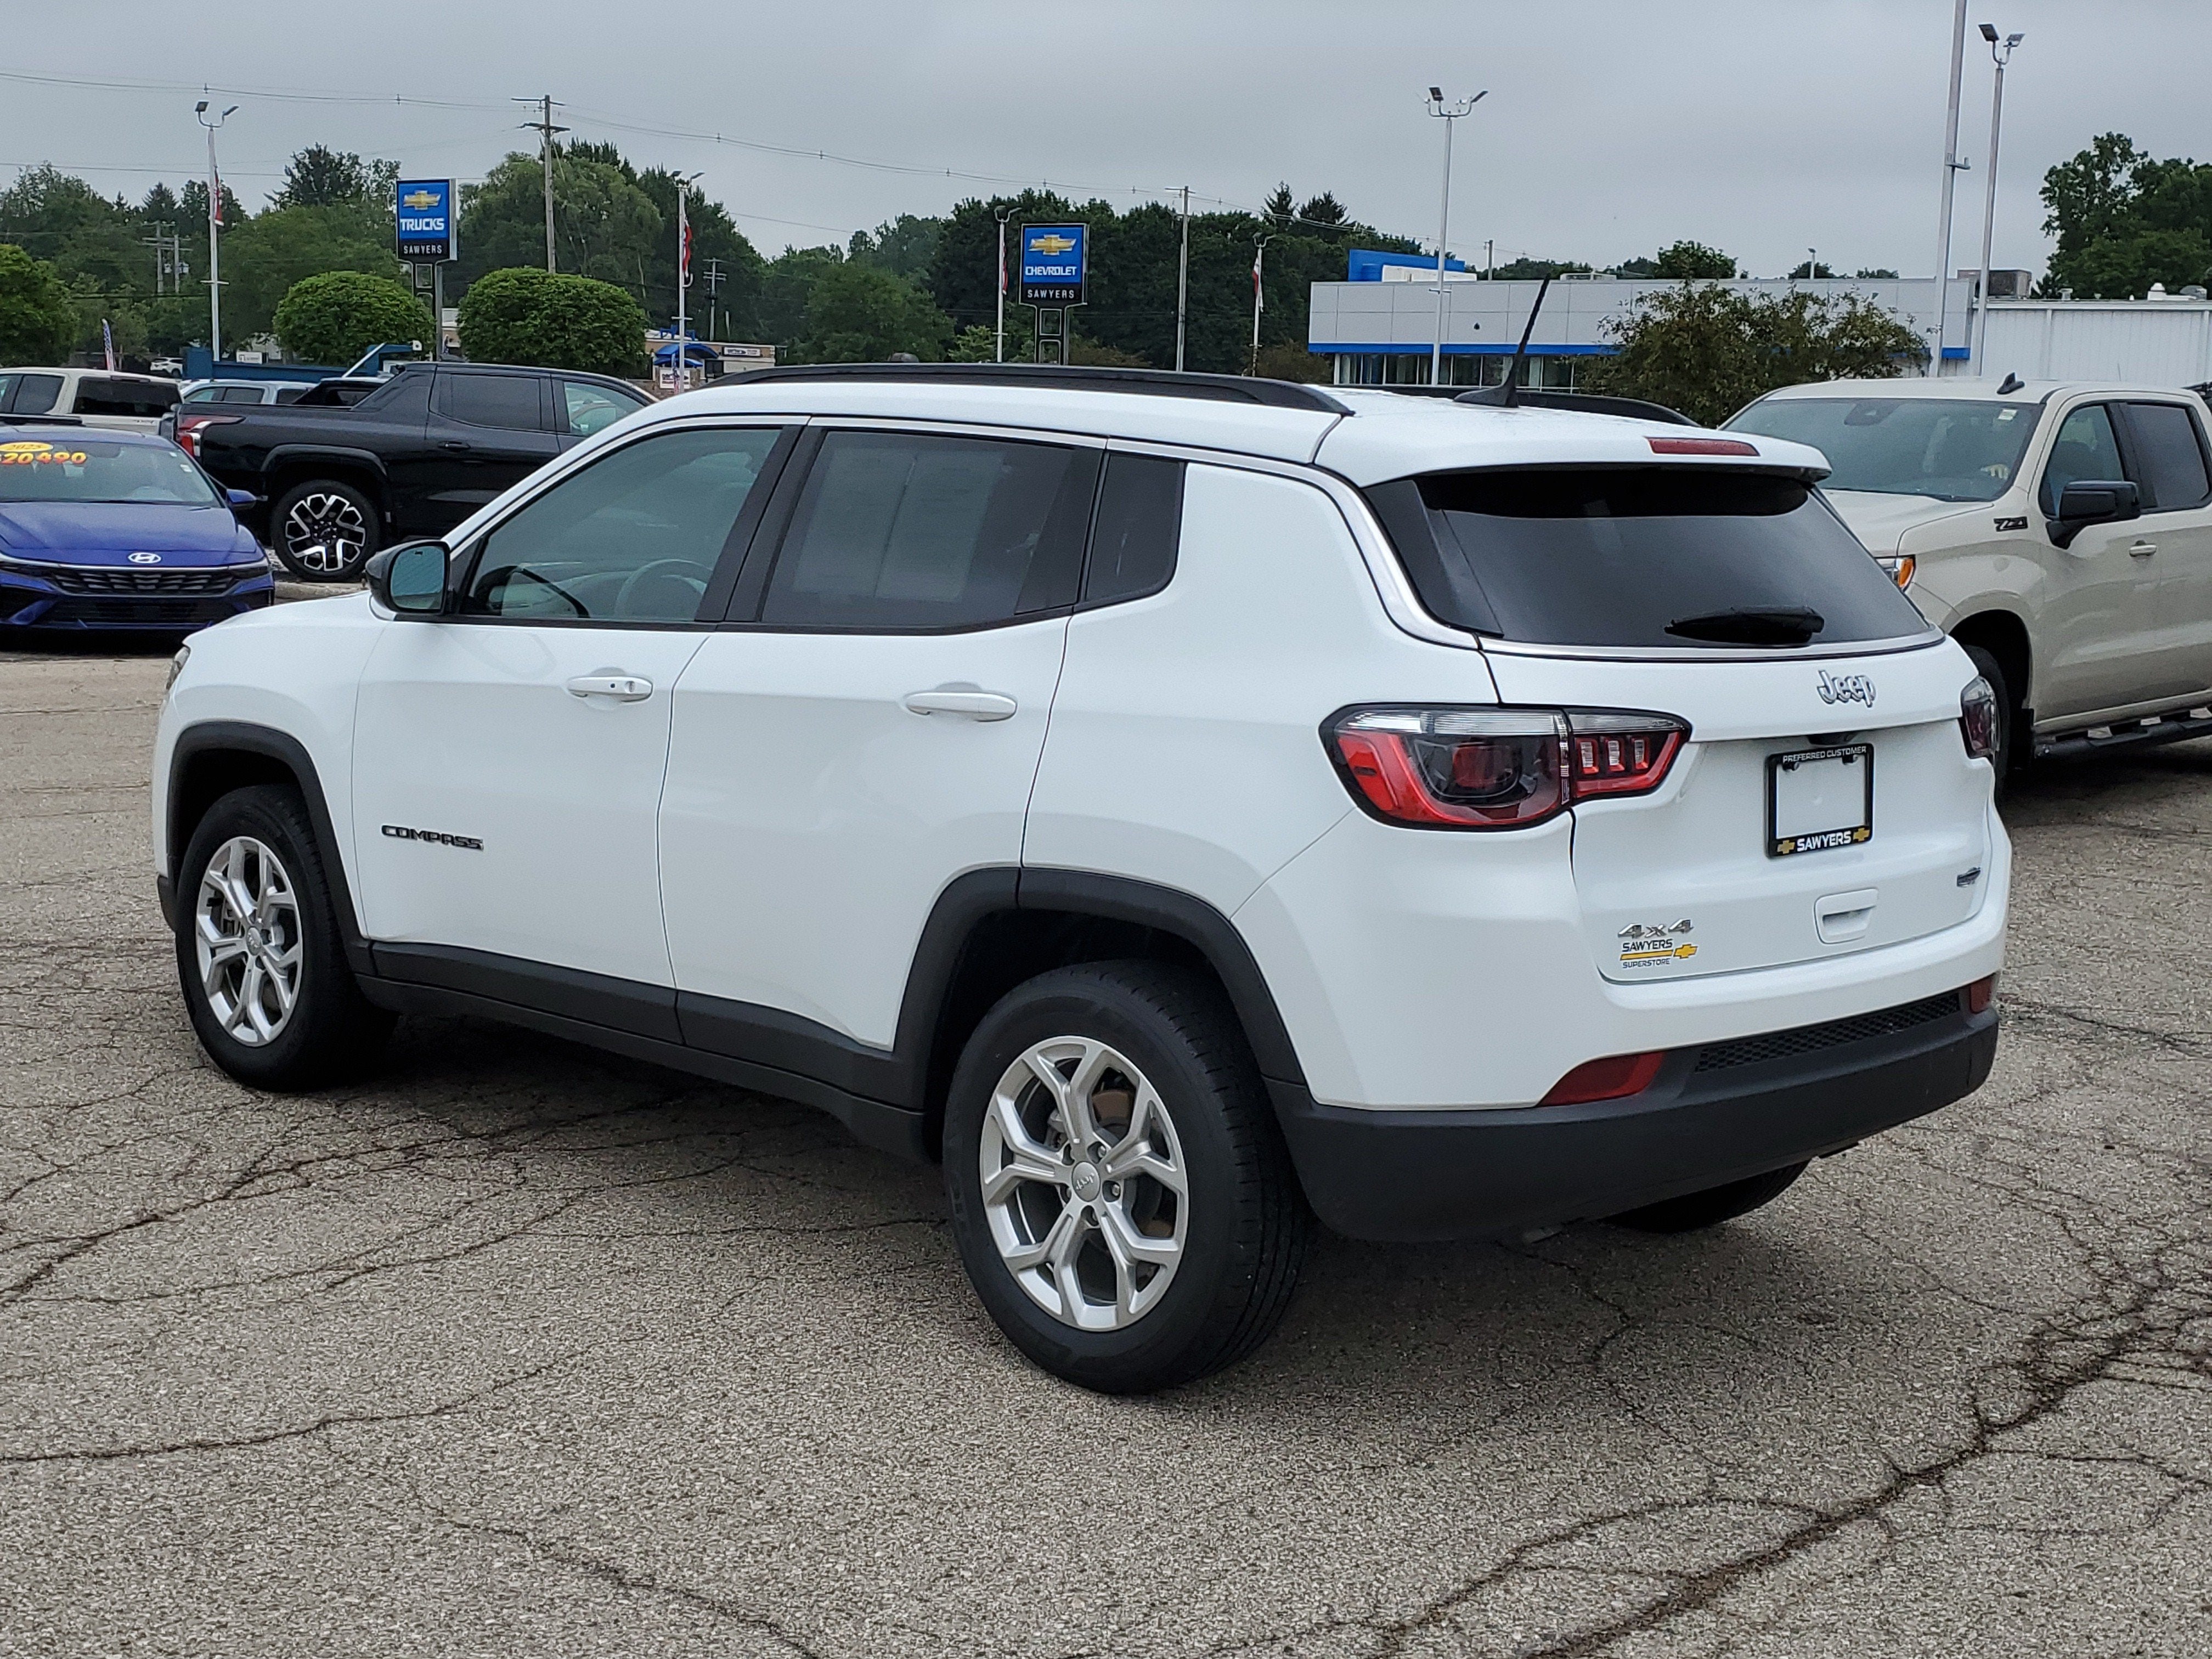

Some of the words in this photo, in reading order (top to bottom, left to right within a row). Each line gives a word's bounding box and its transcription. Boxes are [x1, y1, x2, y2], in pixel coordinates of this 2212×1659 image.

[400, 218, 445, 231] TRUCKS
[403, 245, 442, 254] SAWYERS
[1025, 266, 1077, 275] CHEVROLET
[1027, 289, 1074, 298] SAWYERS
[0, 452, 87, 465] 20490
[1817, 670, 1876, 708] Jeep
[1783, 751, 1826, 763] PREFERRED
[1826, 746, 1866, 758] CUSTOMER
[381, 825, 484, 851] COMPASS
[1797, 831, 1852, 852] SAWYERS
[1622, 939, 1673, 952] SAWYERS
[1622, 958, 1671, 969] SUPERSTORE
